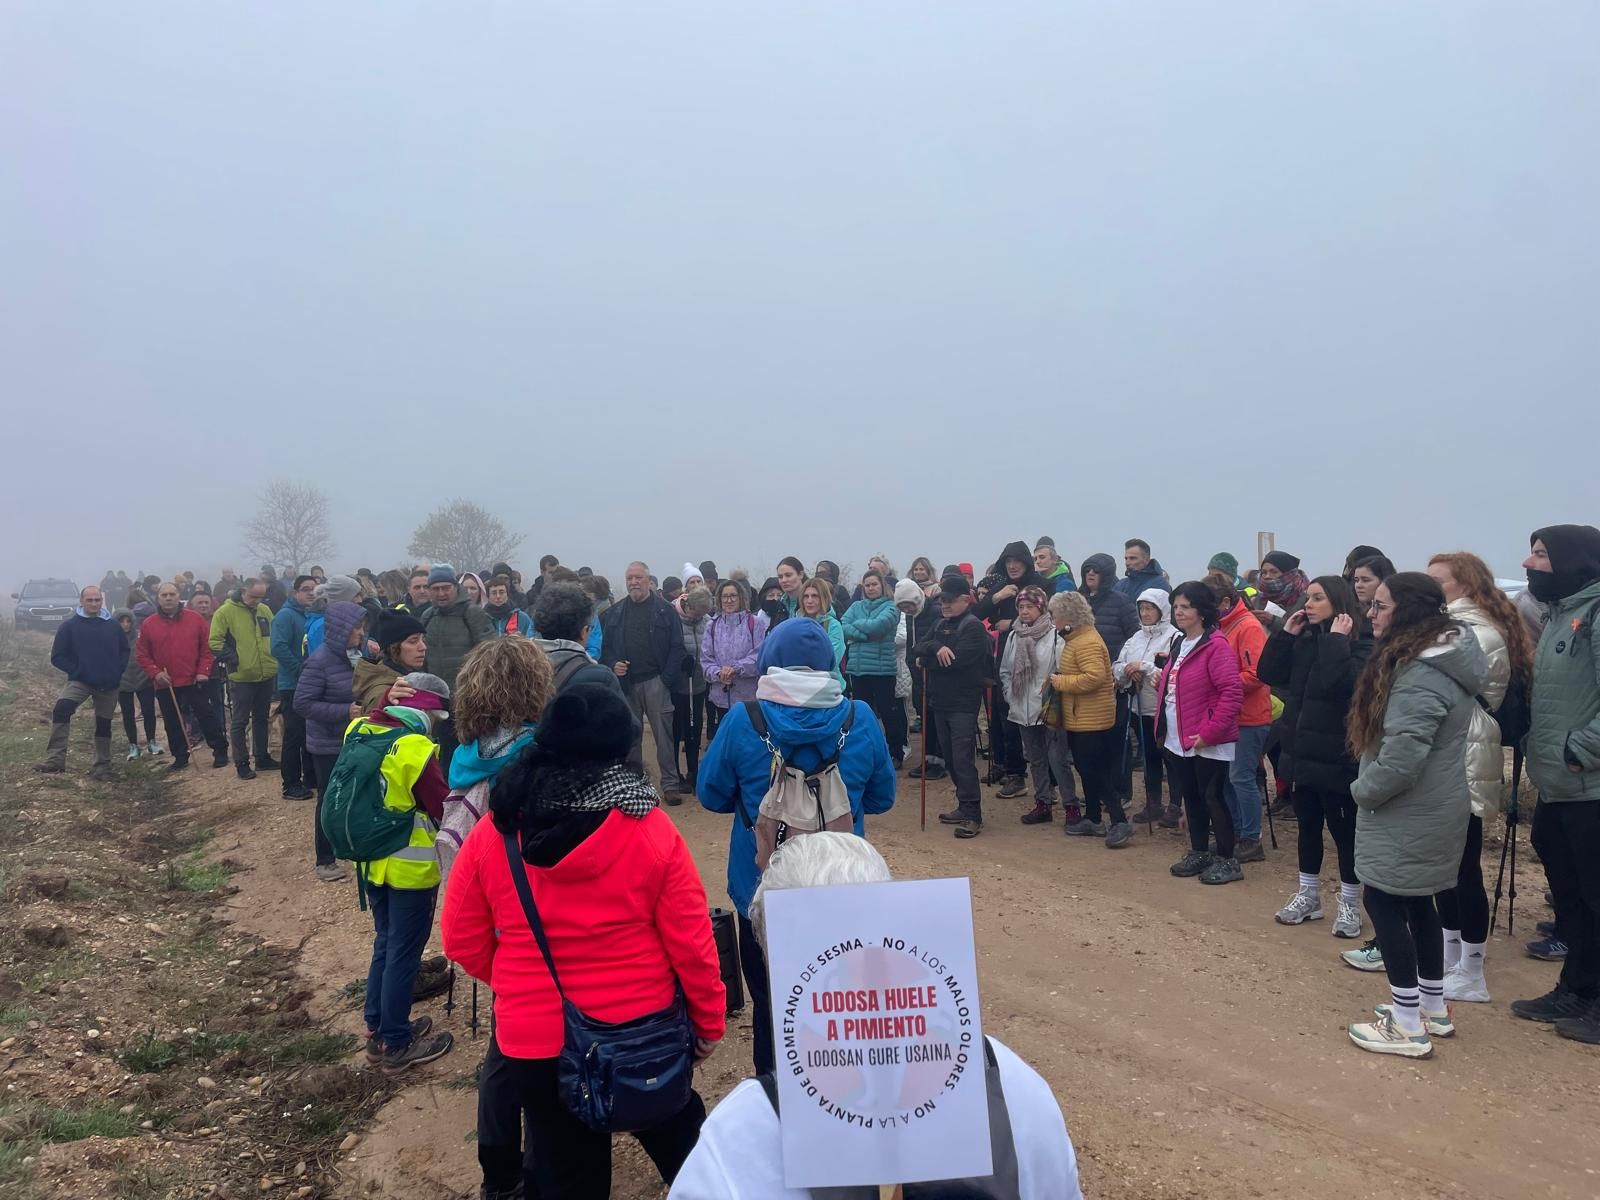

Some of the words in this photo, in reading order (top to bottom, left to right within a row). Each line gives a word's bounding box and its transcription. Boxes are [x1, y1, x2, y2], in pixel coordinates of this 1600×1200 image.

[817, 937, 864, 966] SESMA
[883, 937, 905, 951] NO
[909, 945, 918, 957] A
[800, 963, 818, 983] DE
[921, 951, 947, 976] LOS
[812, 989, 880, 1014] LODOSA
[884, 985, 938, 1011] HUELE
[944, 975, 971, 1026] MALOS
[783, 984, 804, 1076] BIOMETANO
[827, 1019, 839, 1041] A
[844, 1014, 927, 1041] PIMIENTO
[807, 1048, 864, 1068] LODOSAN
[868, 1046, 900, 1066] GURE
[905, 1043, 952, 1063] USAINA
[945, 1032, 972, 1090] OLORES
[800, 1077, 818, 1097] DE
[818, 1095, 873, 1128] PLANTA
[900, 1112, 909, 1124] A
[915, 1099, 936, 1119] NO
[879, 1116, 896, 1128] LA
